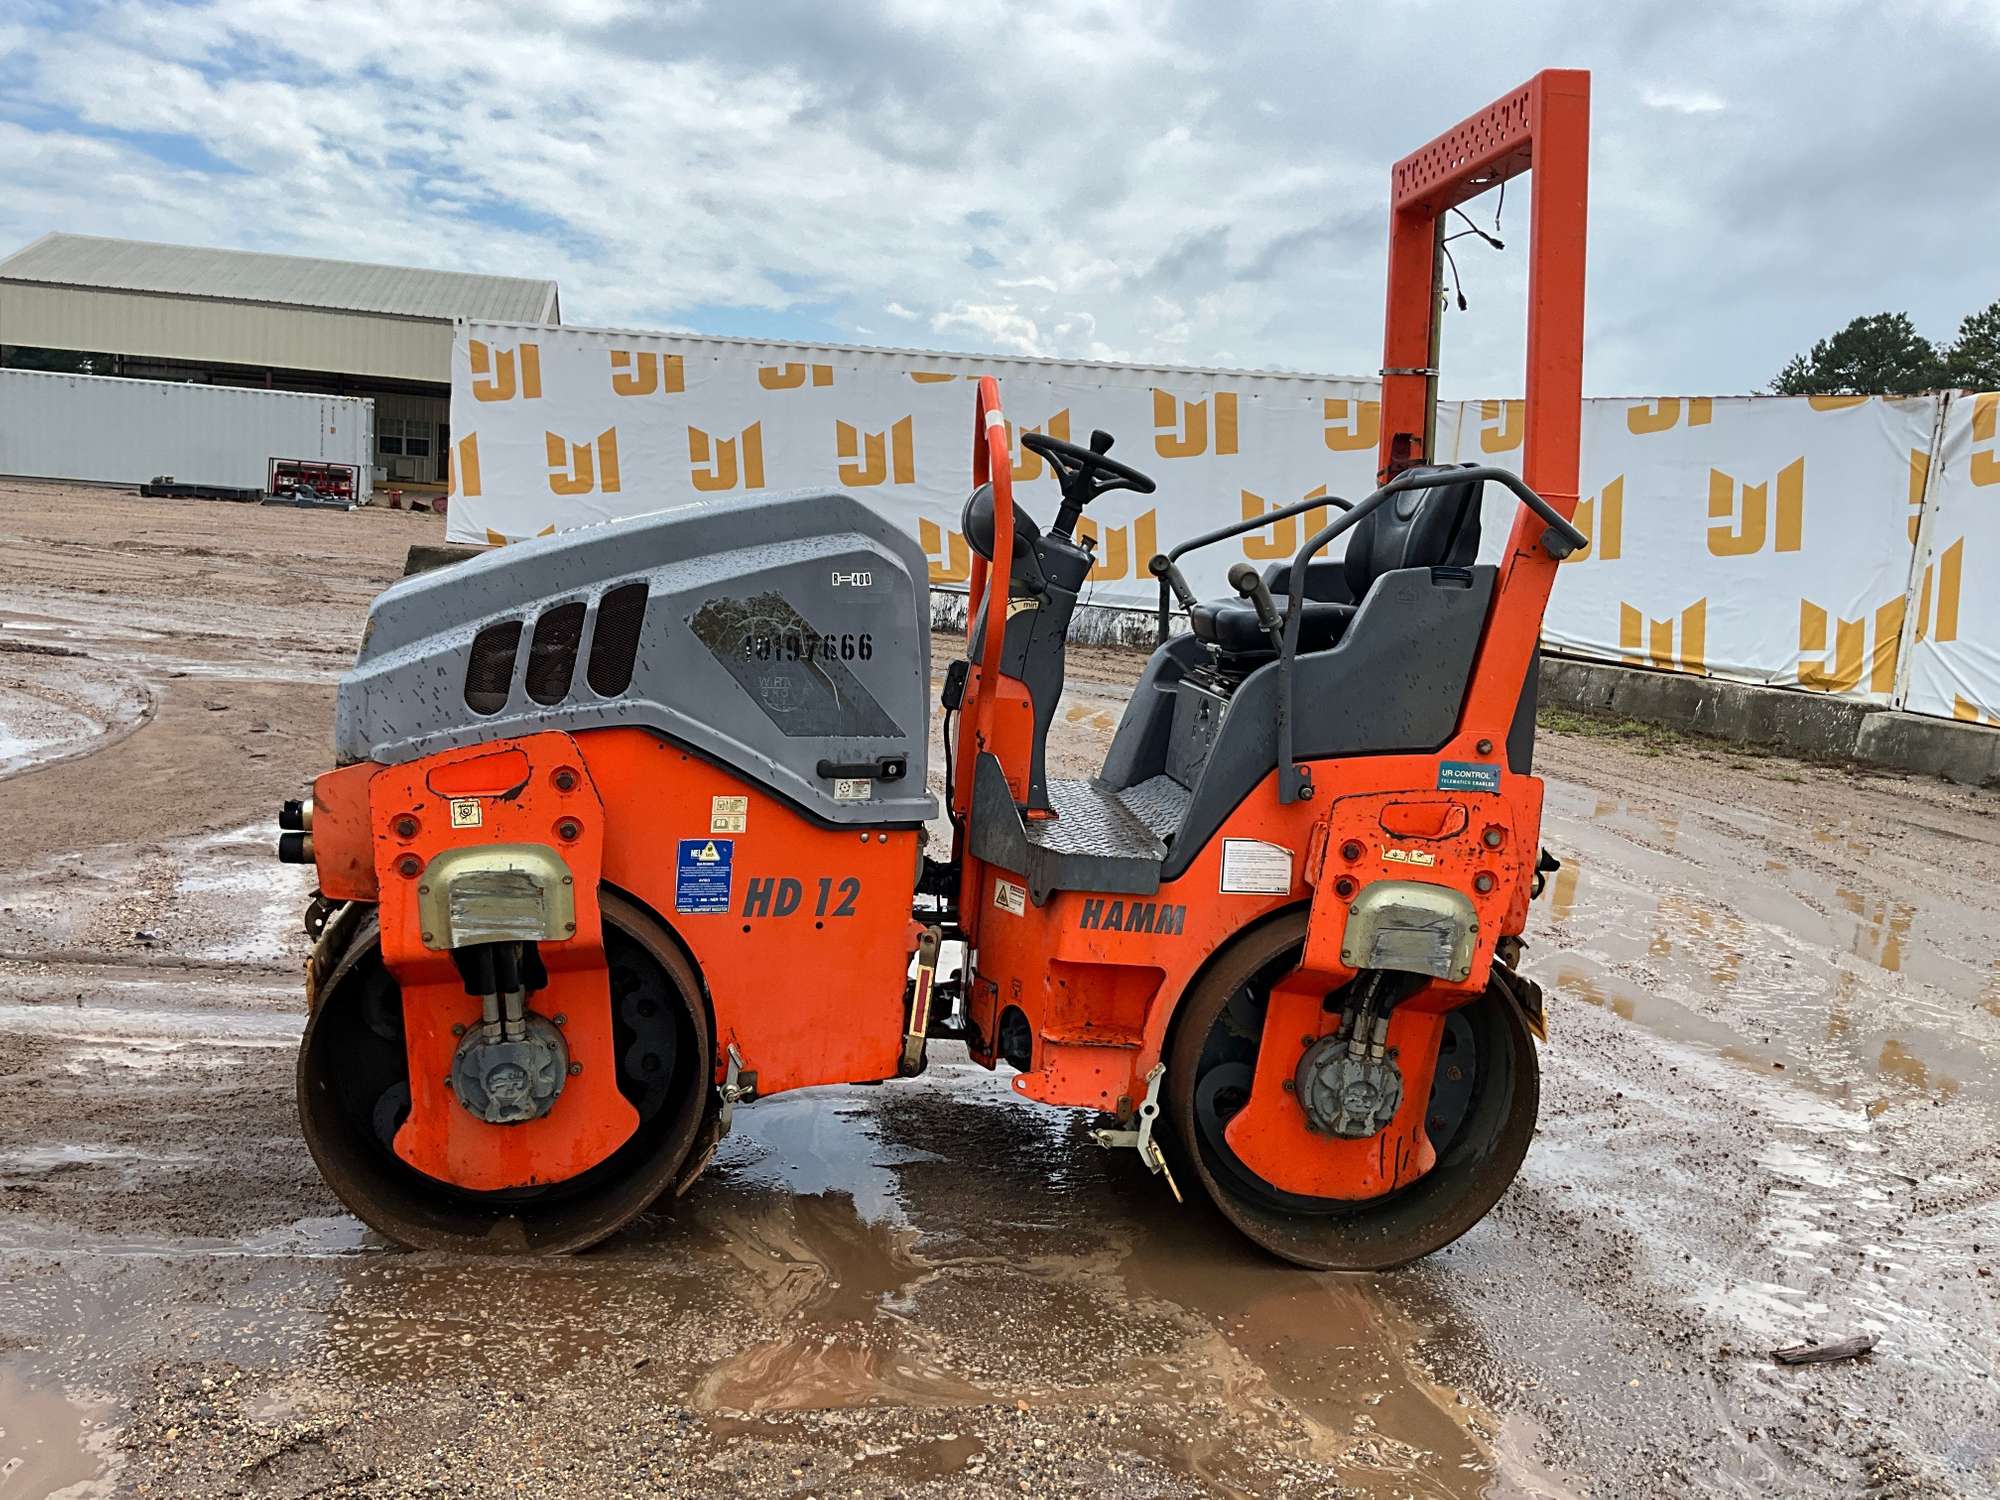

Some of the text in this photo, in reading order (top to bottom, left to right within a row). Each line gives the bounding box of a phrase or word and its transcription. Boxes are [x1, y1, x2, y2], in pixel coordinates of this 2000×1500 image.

[1442, 769, 1491, 780] UR CONTROL
[742, 877, 861, 918] HD 12
[1079, 898, 1187, 936] HAMM
